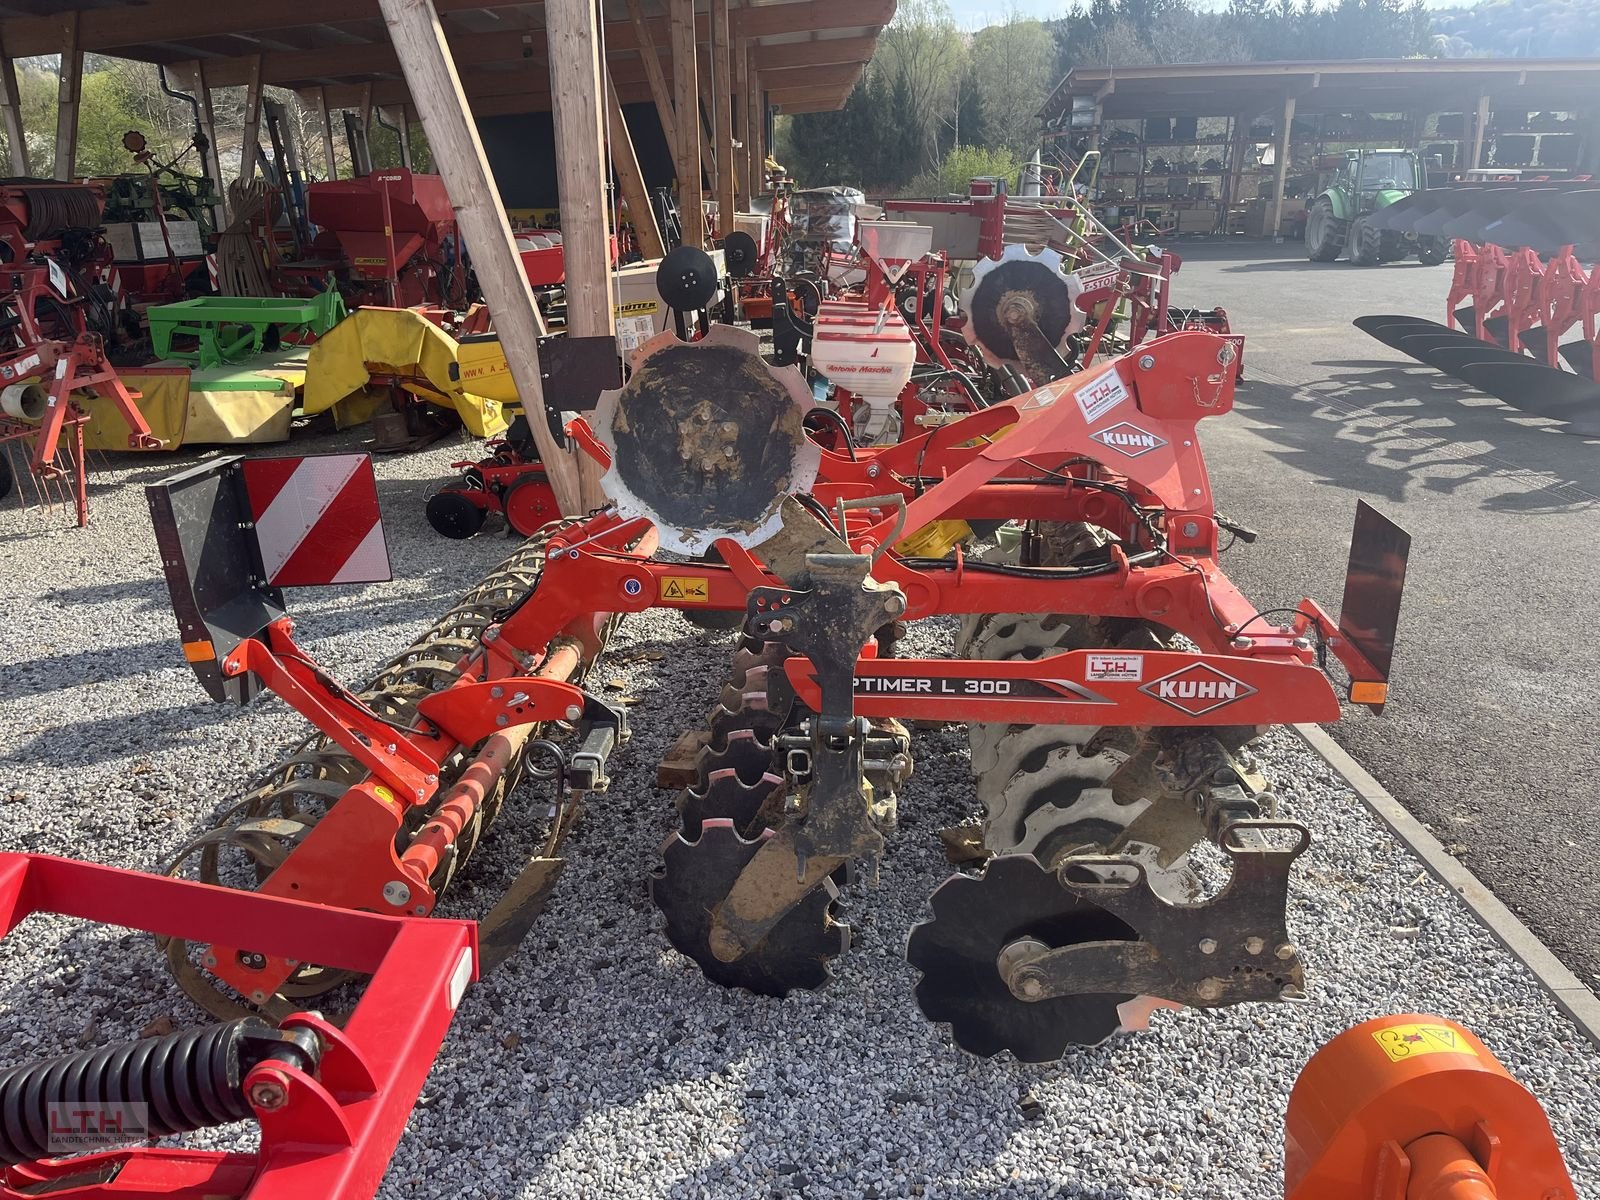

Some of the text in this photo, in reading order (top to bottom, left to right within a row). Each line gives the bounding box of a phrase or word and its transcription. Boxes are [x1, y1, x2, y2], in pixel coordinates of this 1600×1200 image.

[826, 365, 893, 374] Antonio Maschio
[1102, 432, 1155, 447] KUHN
[1091, 661, 1127, 673] LTH
[853, 677, 1011, 694] PTIMER L 300
[1159, 680, 1237, 699] KUHN
